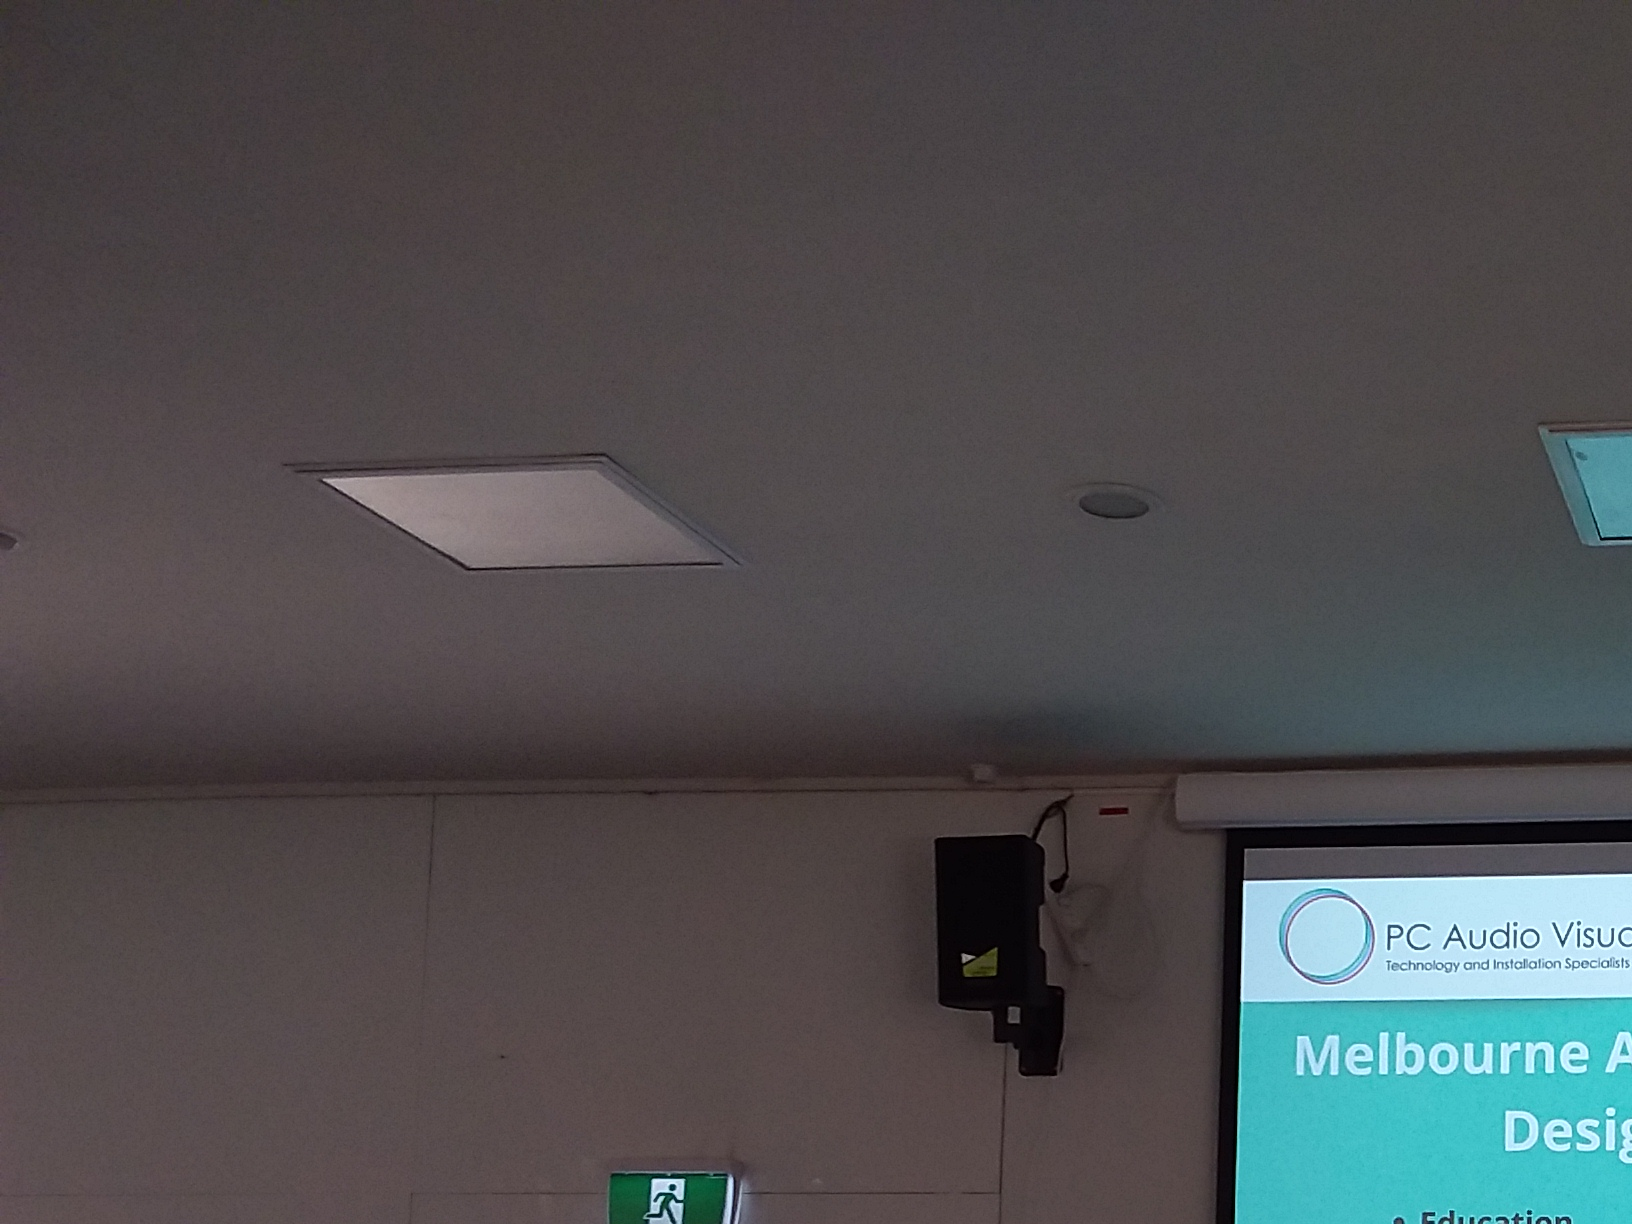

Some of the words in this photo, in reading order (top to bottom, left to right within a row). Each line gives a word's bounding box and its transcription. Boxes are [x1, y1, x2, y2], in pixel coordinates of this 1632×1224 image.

[1386, 923, 1432, 951] PC
[1442, 921, 1541, 951] Audio
[1385, 959, 1461, 974] Technology
[1463, 958, 1490, 971] and
[1493, 958, 1562, 971] Installation
[1564, 956, 1631, 971] Specialists
[1295, 1031, 1590, 1076] Melbourne
